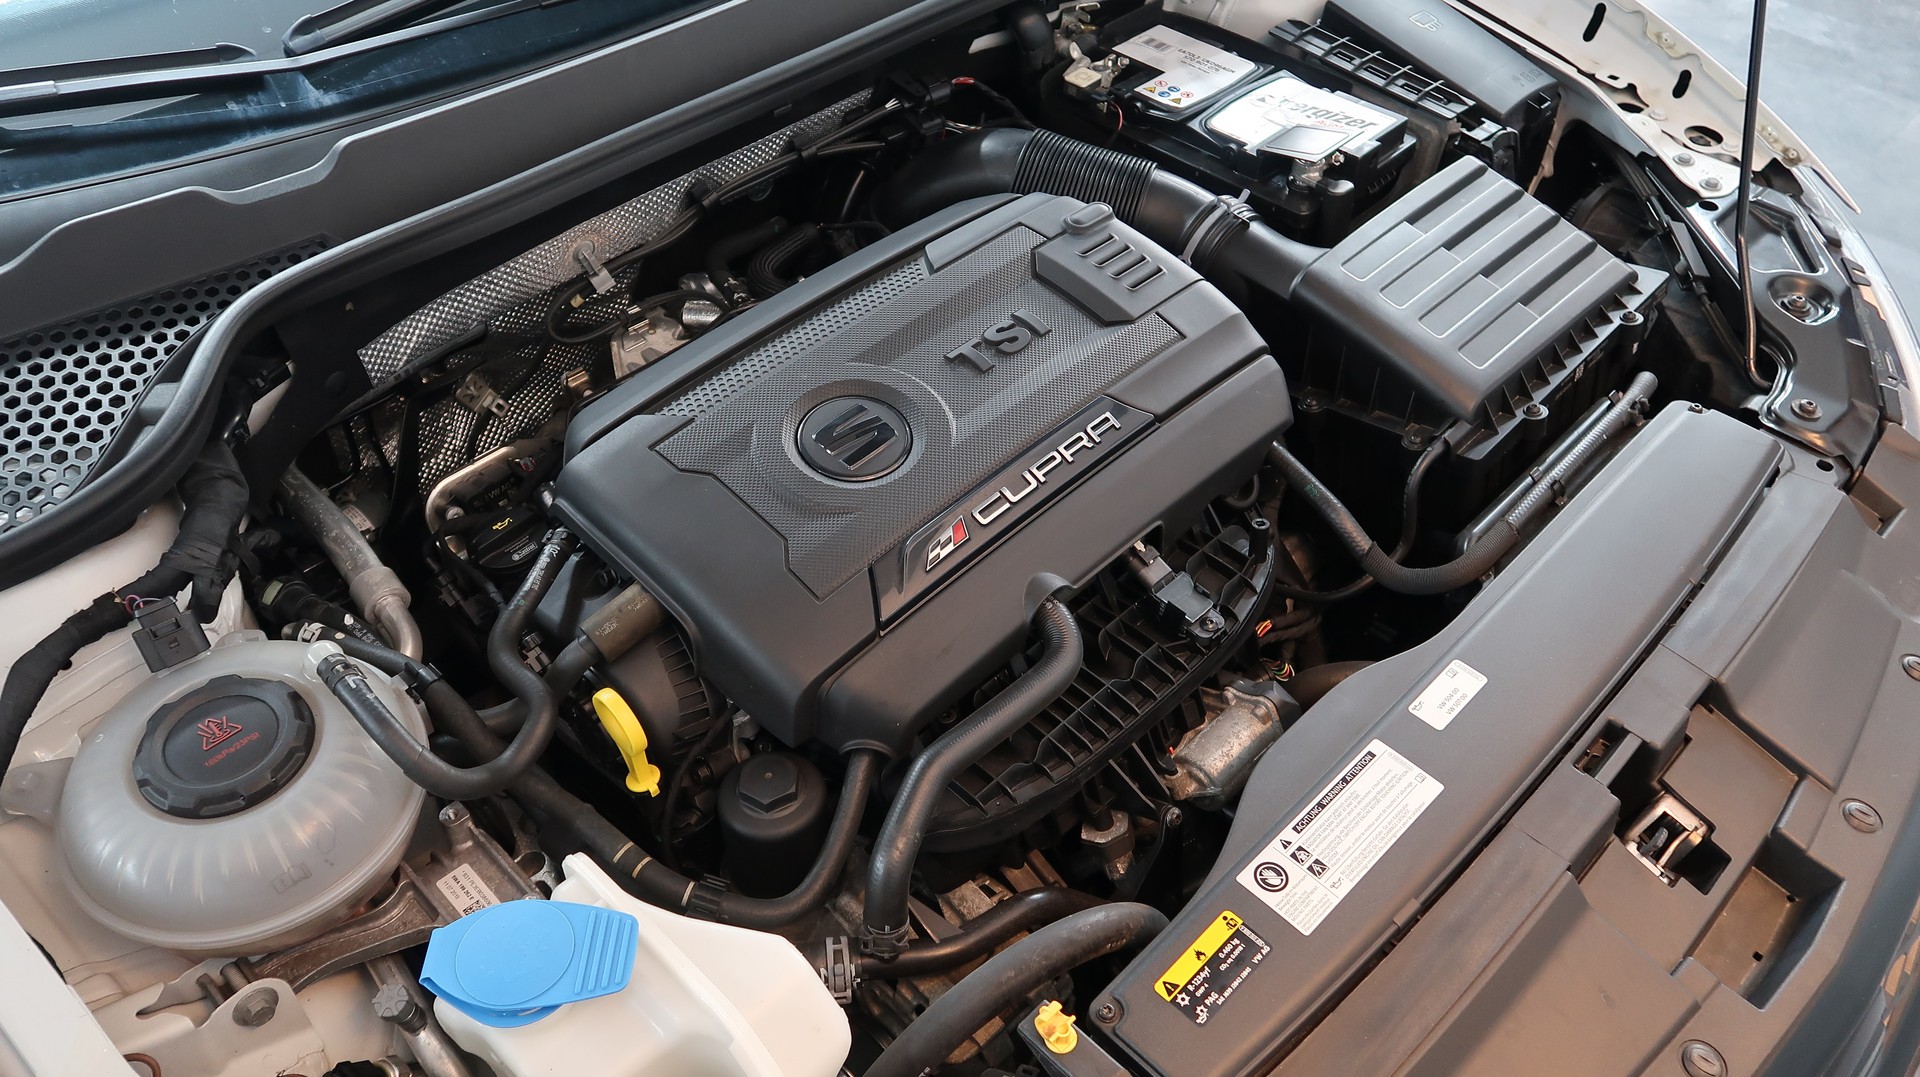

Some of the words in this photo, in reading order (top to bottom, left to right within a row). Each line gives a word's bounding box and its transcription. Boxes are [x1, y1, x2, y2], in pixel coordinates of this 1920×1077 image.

[945, 309, 1052, 375] TSI
[972, 411, 1121, 525] CUPRA
[1294, 804, 1322, 831] ACHTUNG
[1319, 780, 1346, 806] WARNING
[1344, 754, 1373, 781] ATTENTION
[1229, 937, 1240, 946] kg
[1251, 952, 1263, 964] VW
[1259, 944, 1270, 955] AG
[1185, 965, 1213, 992] R-1234yf
[1203, 991, 1219, 1006] PAG
